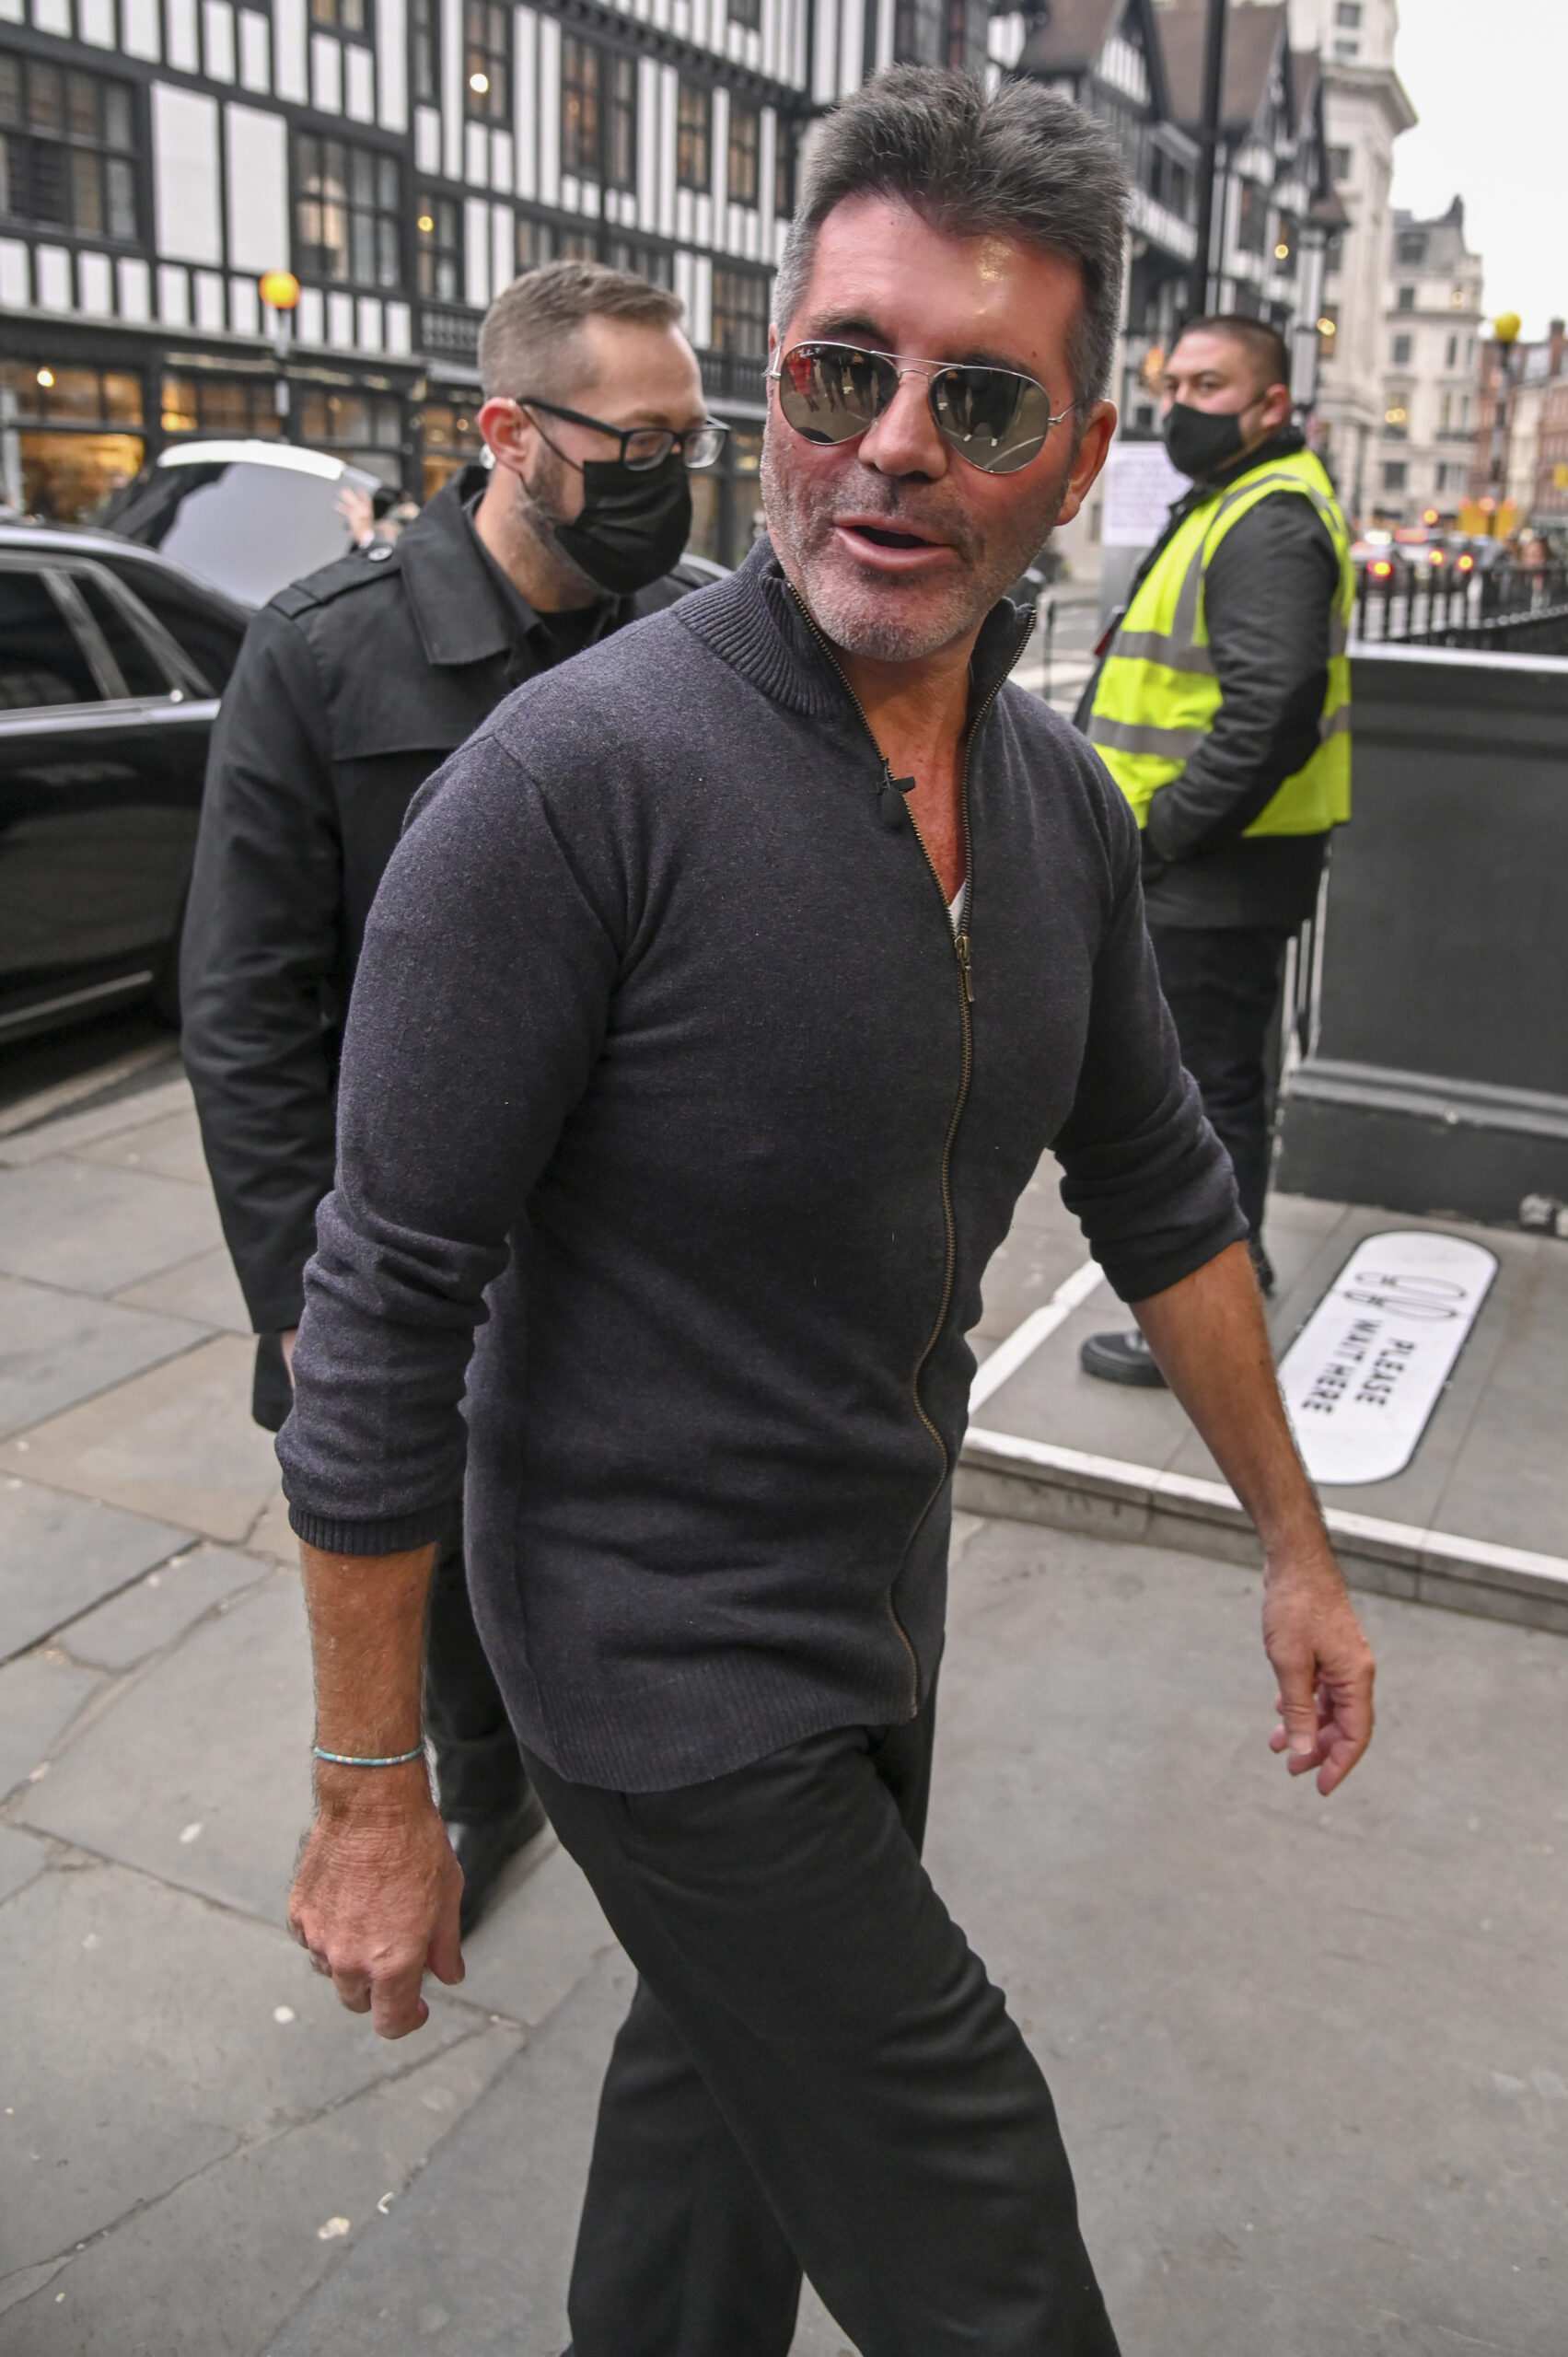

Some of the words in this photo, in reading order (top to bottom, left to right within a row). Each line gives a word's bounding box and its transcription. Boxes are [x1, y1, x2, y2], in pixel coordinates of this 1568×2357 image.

[1334, 1318, 1382, 1363] WAIT
[1301, 1363, 1355, 1413] HERE
[1354, 1337, 1417, 1407] PLEASE
